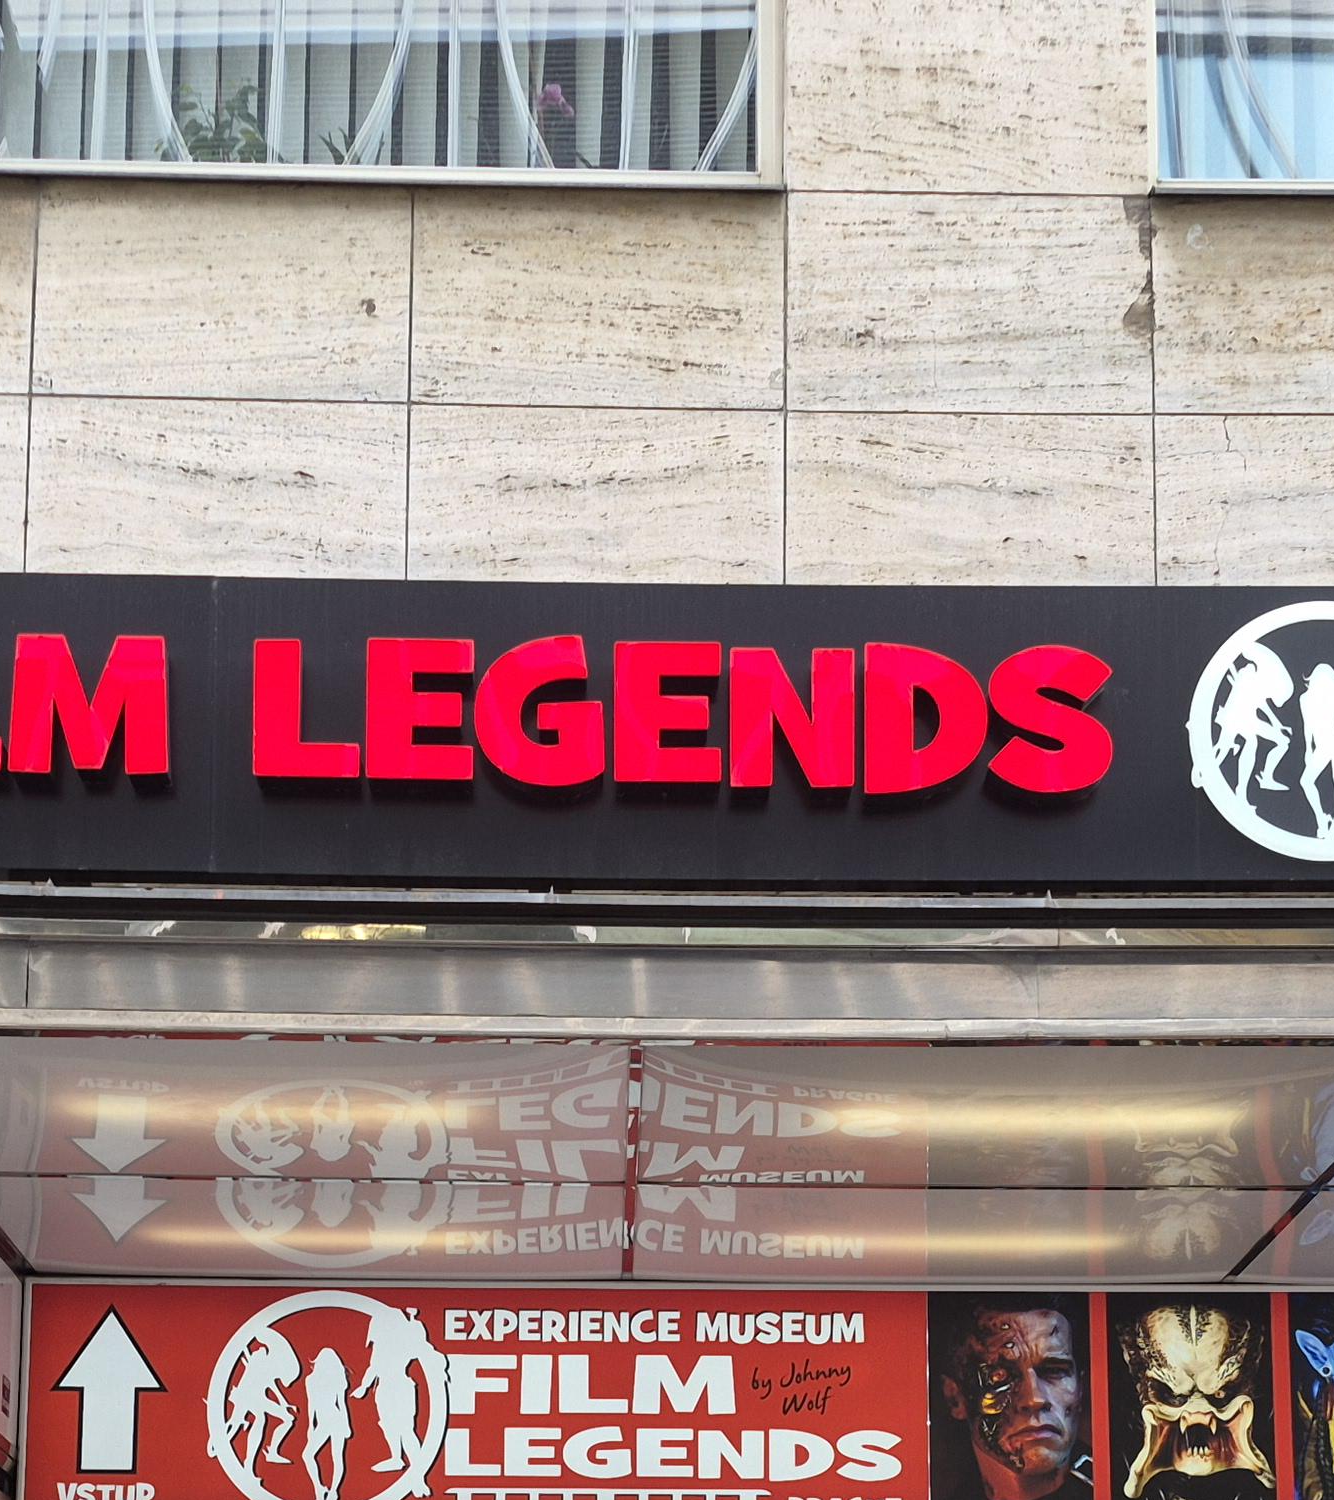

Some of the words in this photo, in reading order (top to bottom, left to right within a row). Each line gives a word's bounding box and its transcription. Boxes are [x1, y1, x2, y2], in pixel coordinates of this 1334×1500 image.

[253, 634, 1115, 796] LEGENDS
[443, 1307, 681, 1344] EXPERIENCE
[694, 1310, 866, 1345] MUSEUM
[445, 1353, 737, 1416] FILM
[750, 1370, 774, 1397] by
[778, 1359, 854, 1394] Johnny
[781, 1386, 835, 1417] Wolf
[442, 1425, 904, 1482] LEGENDS
